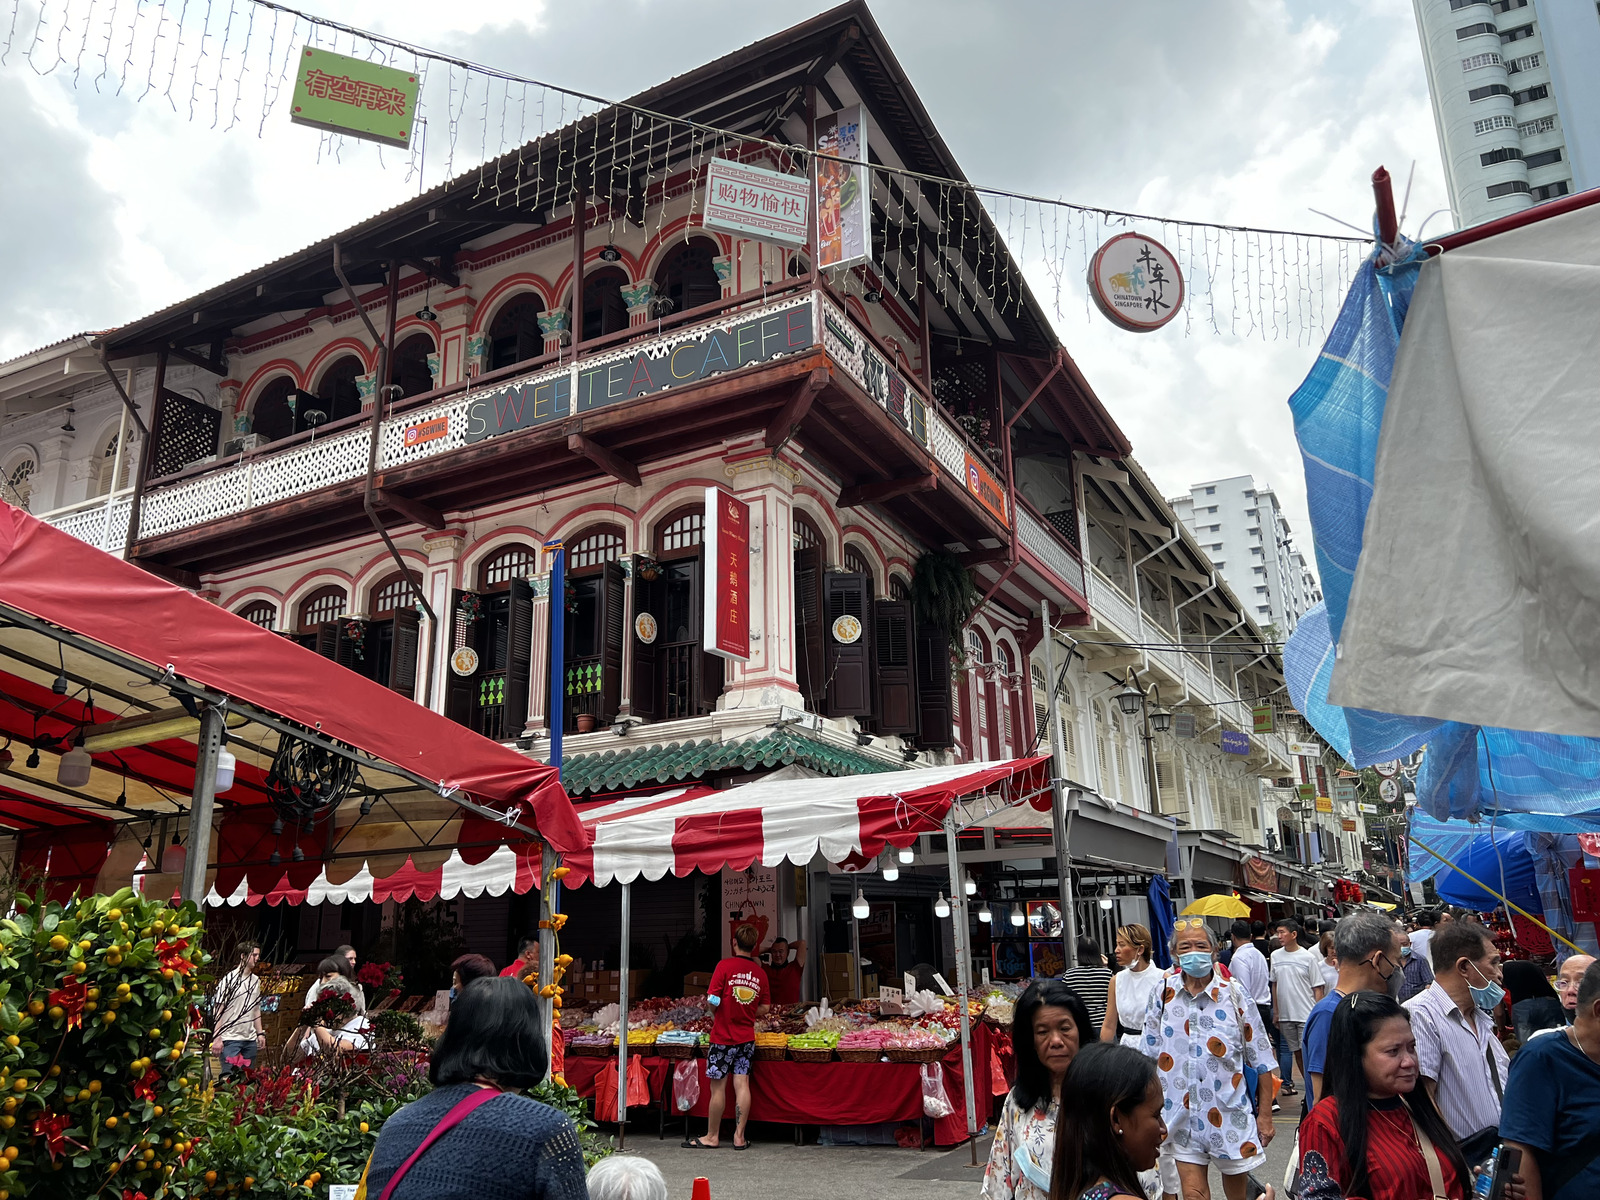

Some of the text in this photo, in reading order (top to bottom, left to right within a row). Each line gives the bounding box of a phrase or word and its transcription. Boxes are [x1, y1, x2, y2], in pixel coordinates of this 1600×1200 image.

[304, 68, 407, 118] 有空再来
[717, 181, 801, 219] 购物愉快
[1135, 243, 1171, 316] 牛车水
[1113, 293, 1143, 302] CHINATOWN
[1114, 300, 1143, 309] SINGAPORE
[669, 307, 807, 381] CAFFE
[418, 421, 446, 438] #SGWINE
[725, 898, 765, 909] CHINATOWN
[1030, 917, 1062, 934] Tiger
[997, 957, 1027, 977] Tiger
[1033, 957, 1065, 977] Tiger
